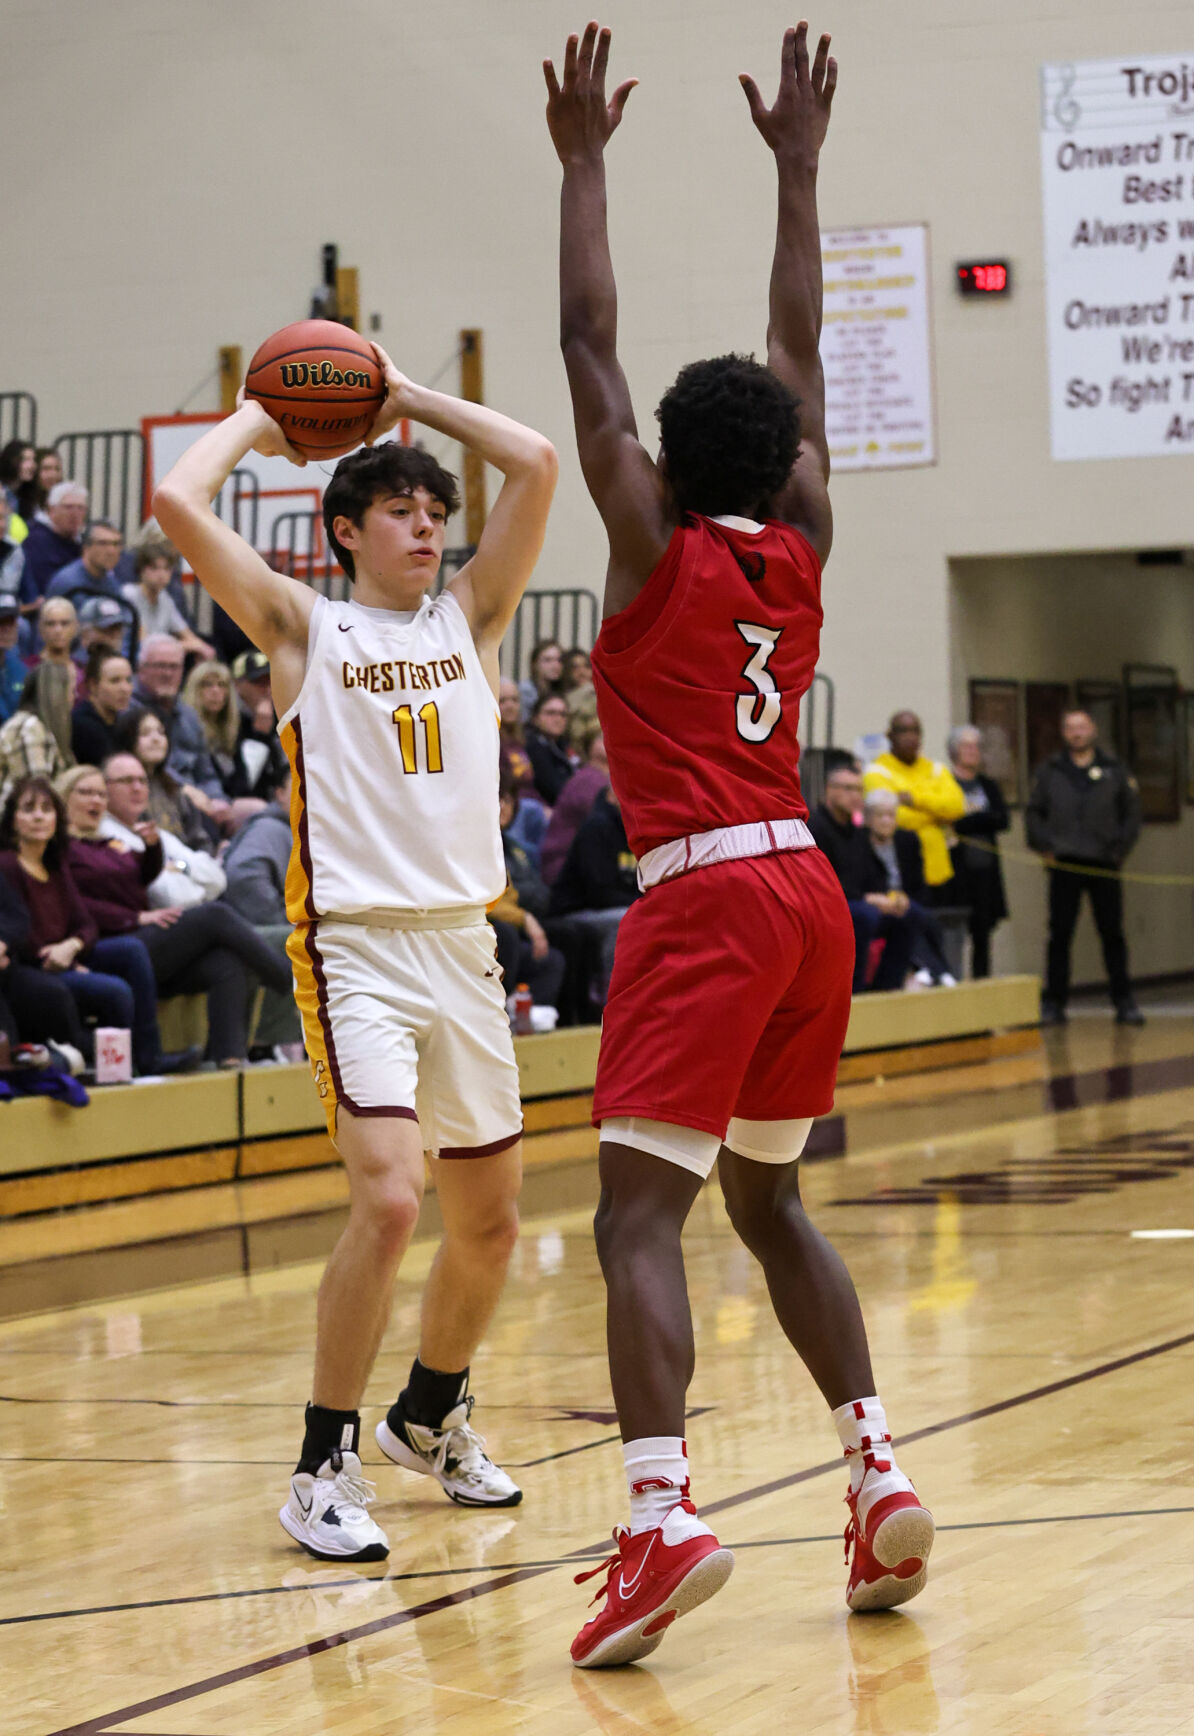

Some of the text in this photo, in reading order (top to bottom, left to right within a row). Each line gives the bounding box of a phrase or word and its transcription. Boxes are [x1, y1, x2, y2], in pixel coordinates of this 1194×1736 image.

[1121, 63, 1194, 102] Troj
[1057, 133, 1163, 171] Onward
[1122, 175, 1184, 204] Best
[1071, 218, 1168, 252] Always
[1064, 296, 1170, 330] Onward
[1121, 335, 1194, 364] We're
[280, 360, 372, 389] Wilson
[1065, 378, 1102, 409] So
[1108, 375, 1170, 413] fight
[341, 652, 466, 693] CHESTERTON
[733, 619, 785, 745] 3
[392, 700, 444, 775] 11
